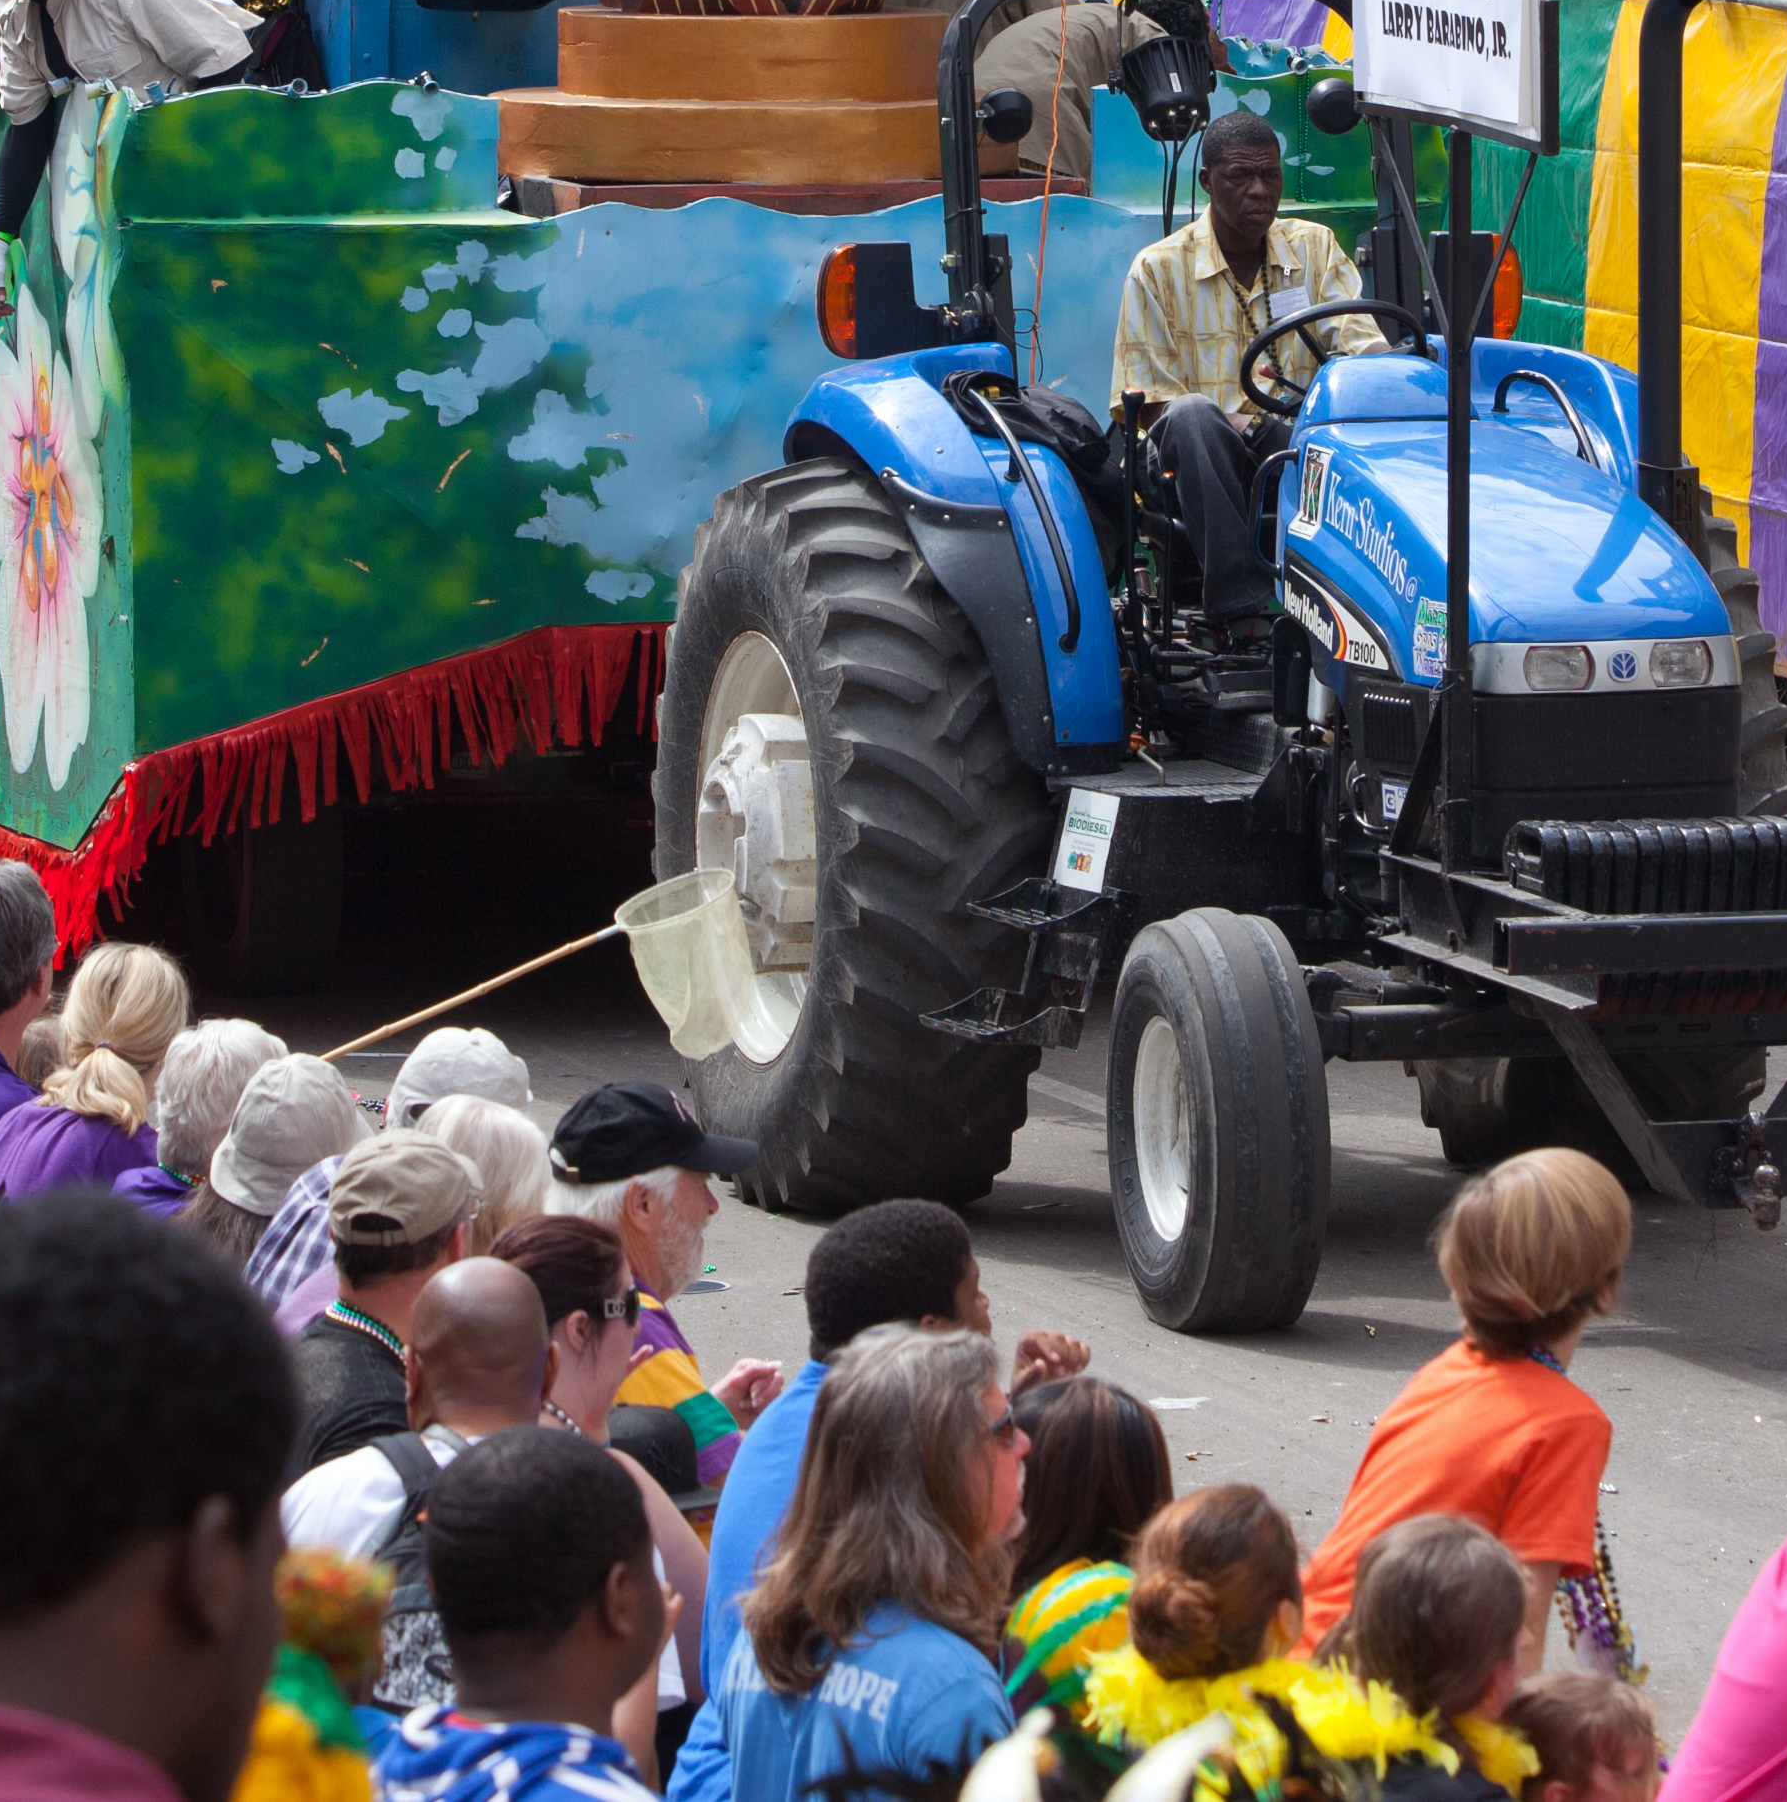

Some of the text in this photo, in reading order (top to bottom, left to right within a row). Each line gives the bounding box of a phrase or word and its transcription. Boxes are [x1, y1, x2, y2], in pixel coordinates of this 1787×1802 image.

[1381, 0, 1512, 63] LARRY BARABINO, JR.
[1305, 380, 1321, 416] 4
[1284, 579, 1334, 652] New Holland
[1348, 638, 1377, 666] TB100
[1068, 817, 1110, 836] BIODIESEL
[817, 1660, 900, 1724] HOPE
